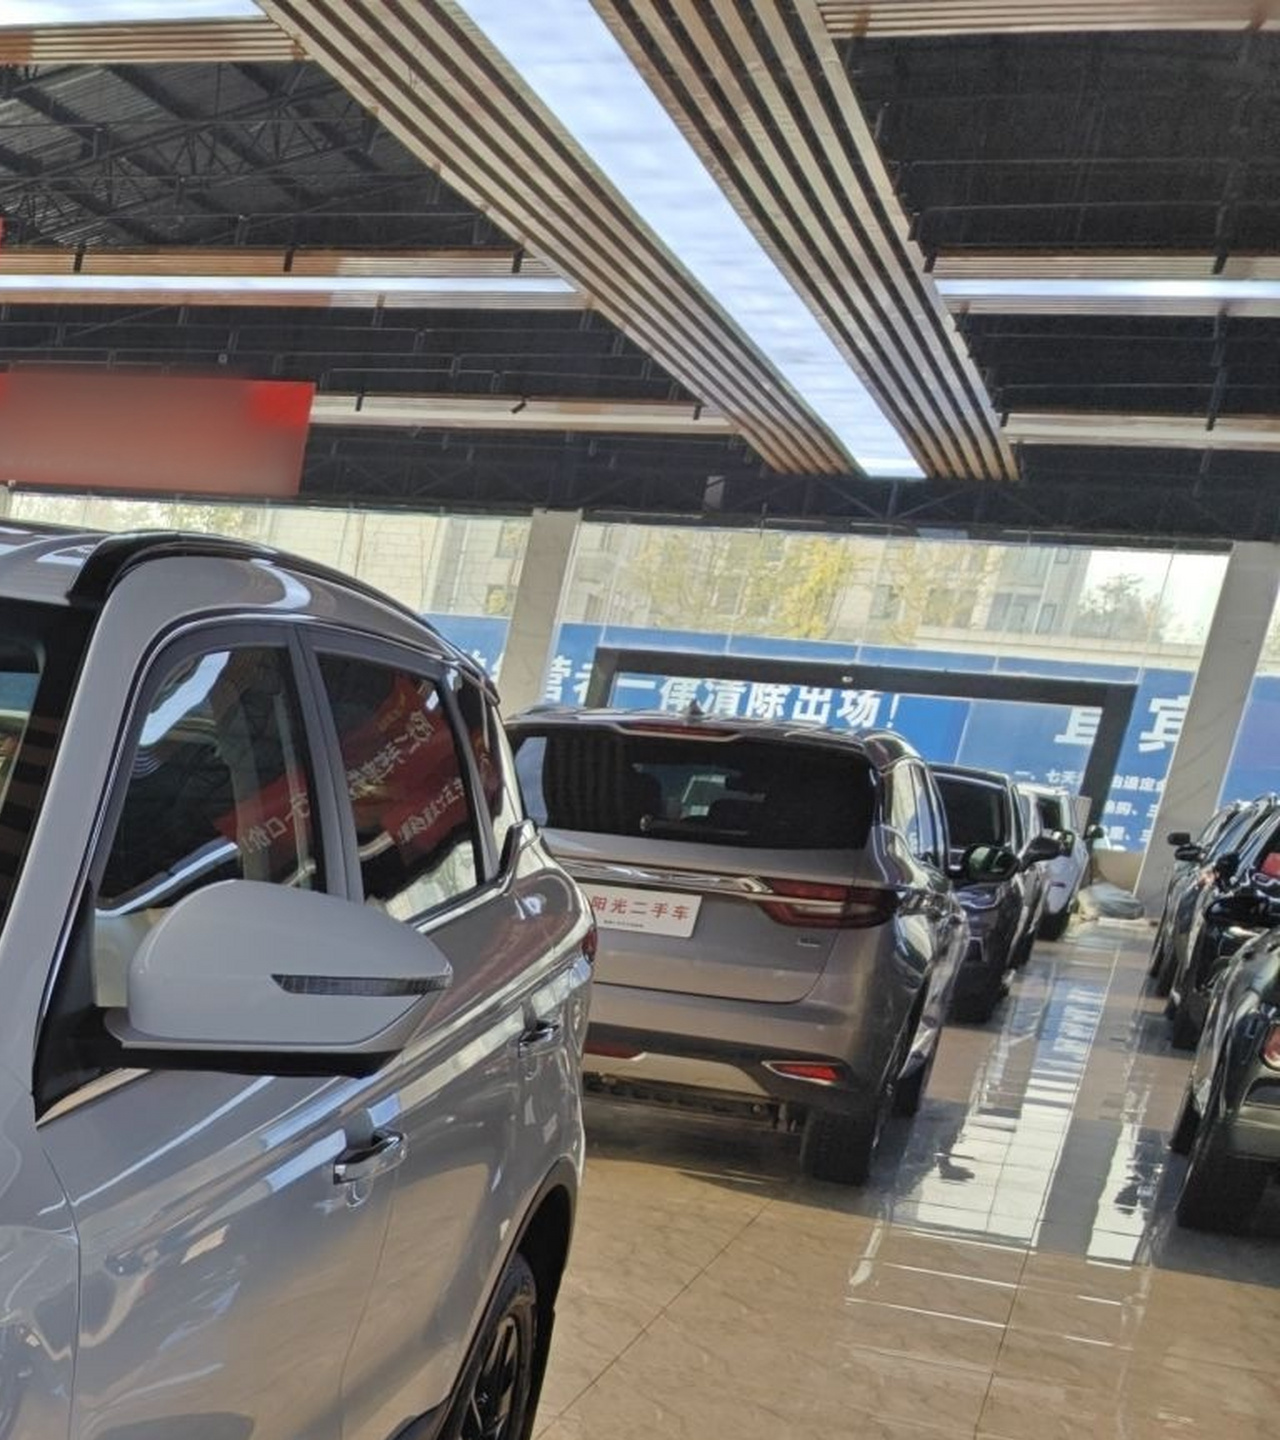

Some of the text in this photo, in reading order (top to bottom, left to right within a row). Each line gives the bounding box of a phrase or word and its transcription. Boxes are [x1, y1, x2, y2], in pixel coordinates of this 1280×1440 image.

[591, 895, 690, 922] 阳光二手车
